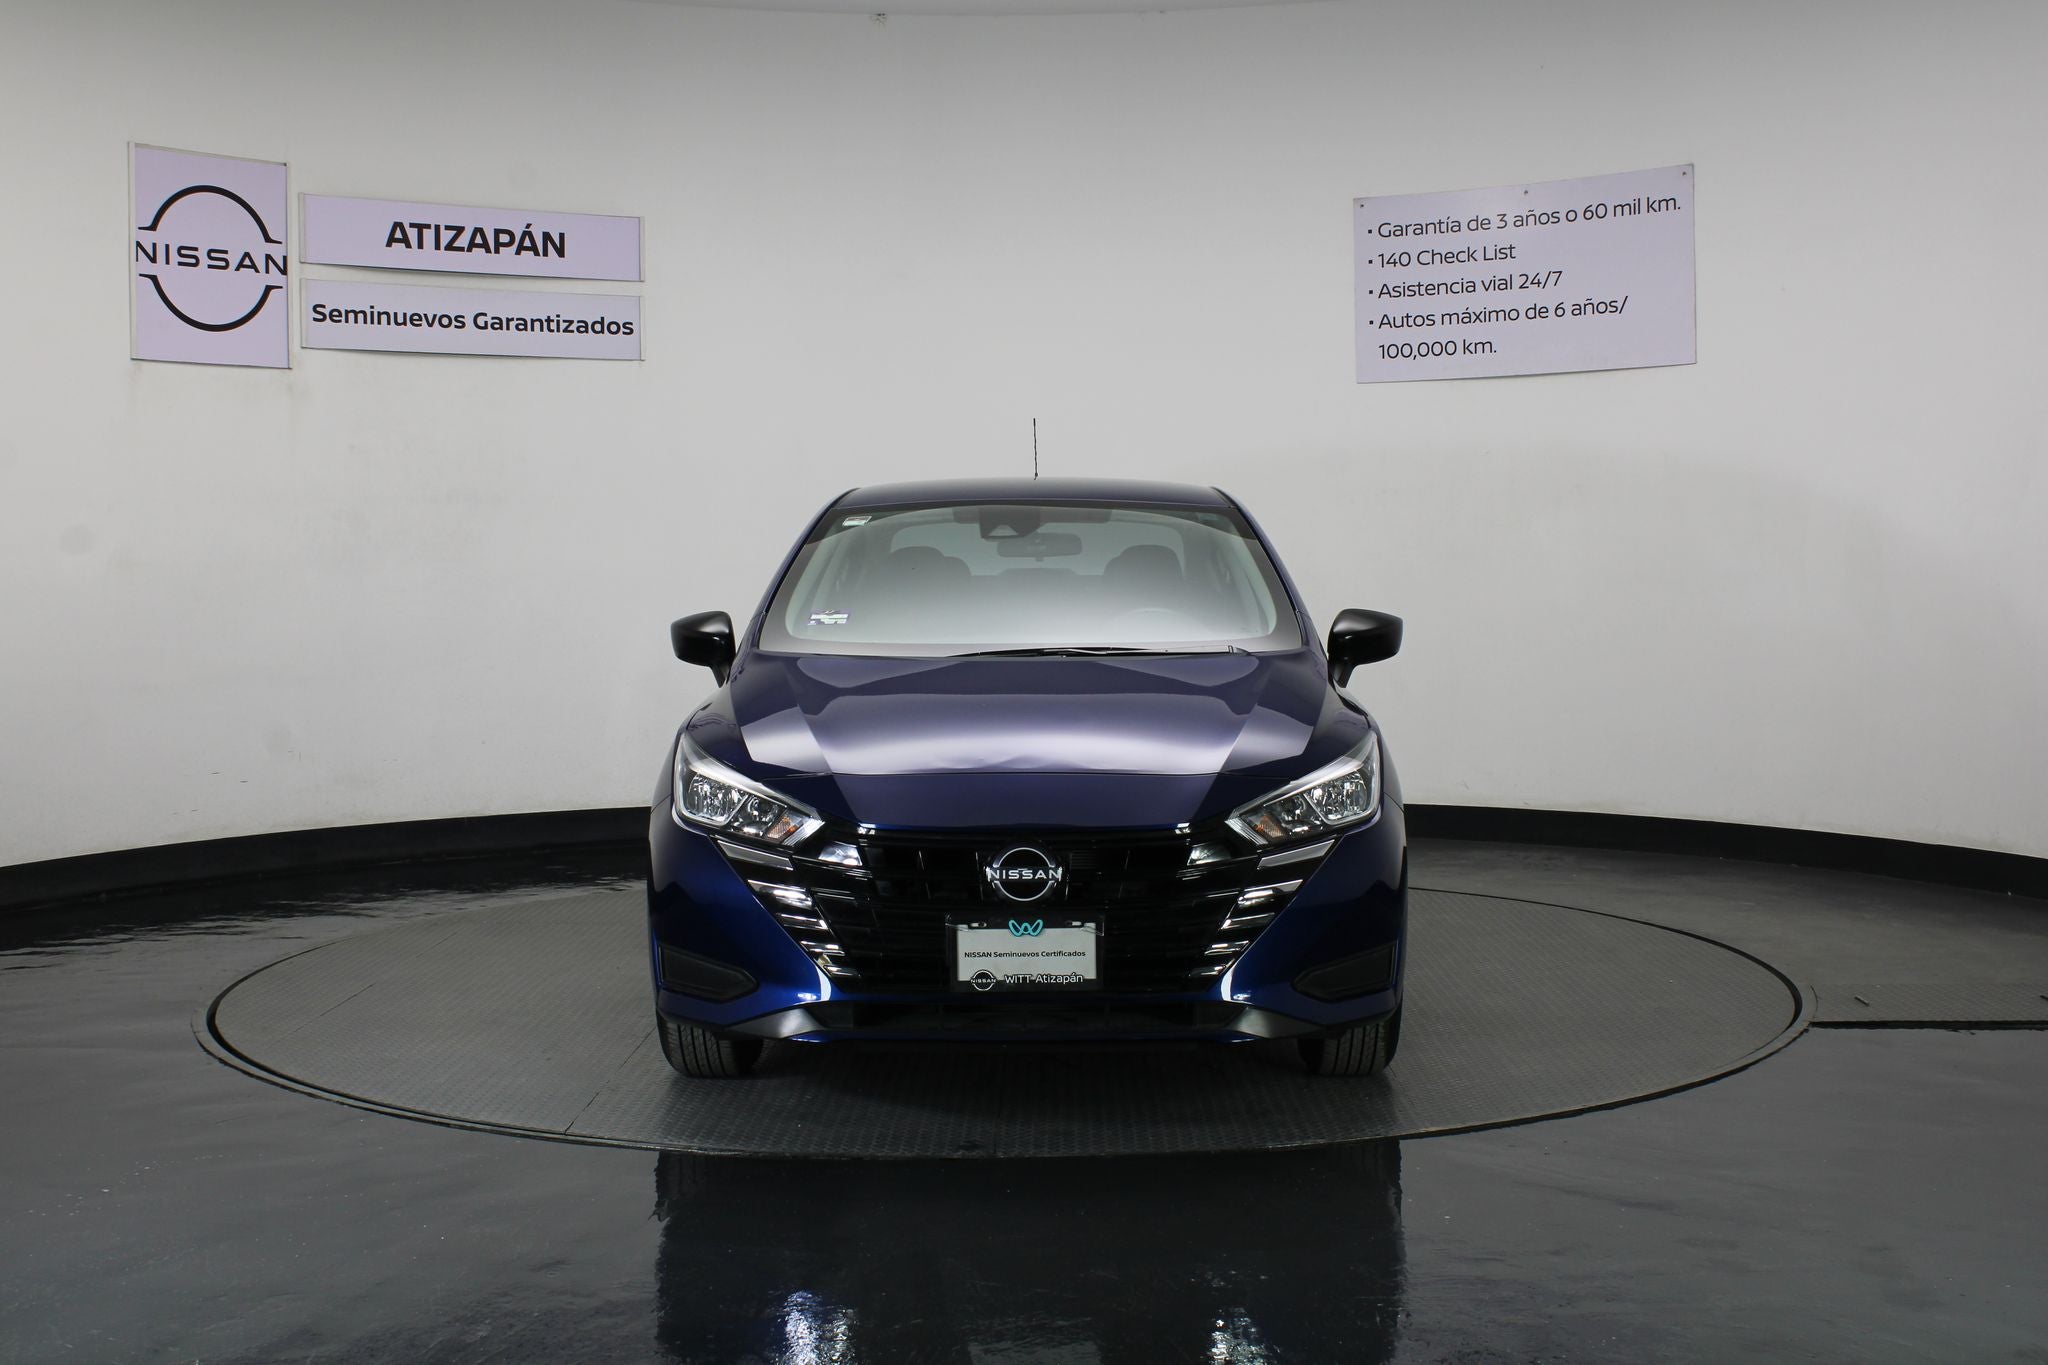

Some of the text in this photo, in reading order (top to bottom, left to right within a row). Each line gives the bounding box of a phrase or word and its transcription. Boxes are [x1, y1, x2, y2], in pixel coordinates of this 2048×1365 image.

[1378, 196, 1681, 239] Garantía de 3 años o 60 mil km.
[385, 221, 566, 259] ATIZAPÁN
[1378, 243, 1516, 268] 140 Check List
[135, 240, 288, 276] NISSAN
[1378, 270, 1563, 299] Asistencia vial 24/7
[312, 303, 635, 336] Seminuevos Garantizados
[1378, 295, 1629, 329] Autos máximo de 6 años/
[1379, 338, 1497, 361] 100,000 km.
[986, 868, 1063, 881] NISSAN
[1004, 972, 1083, 985] WITT Atizapán
